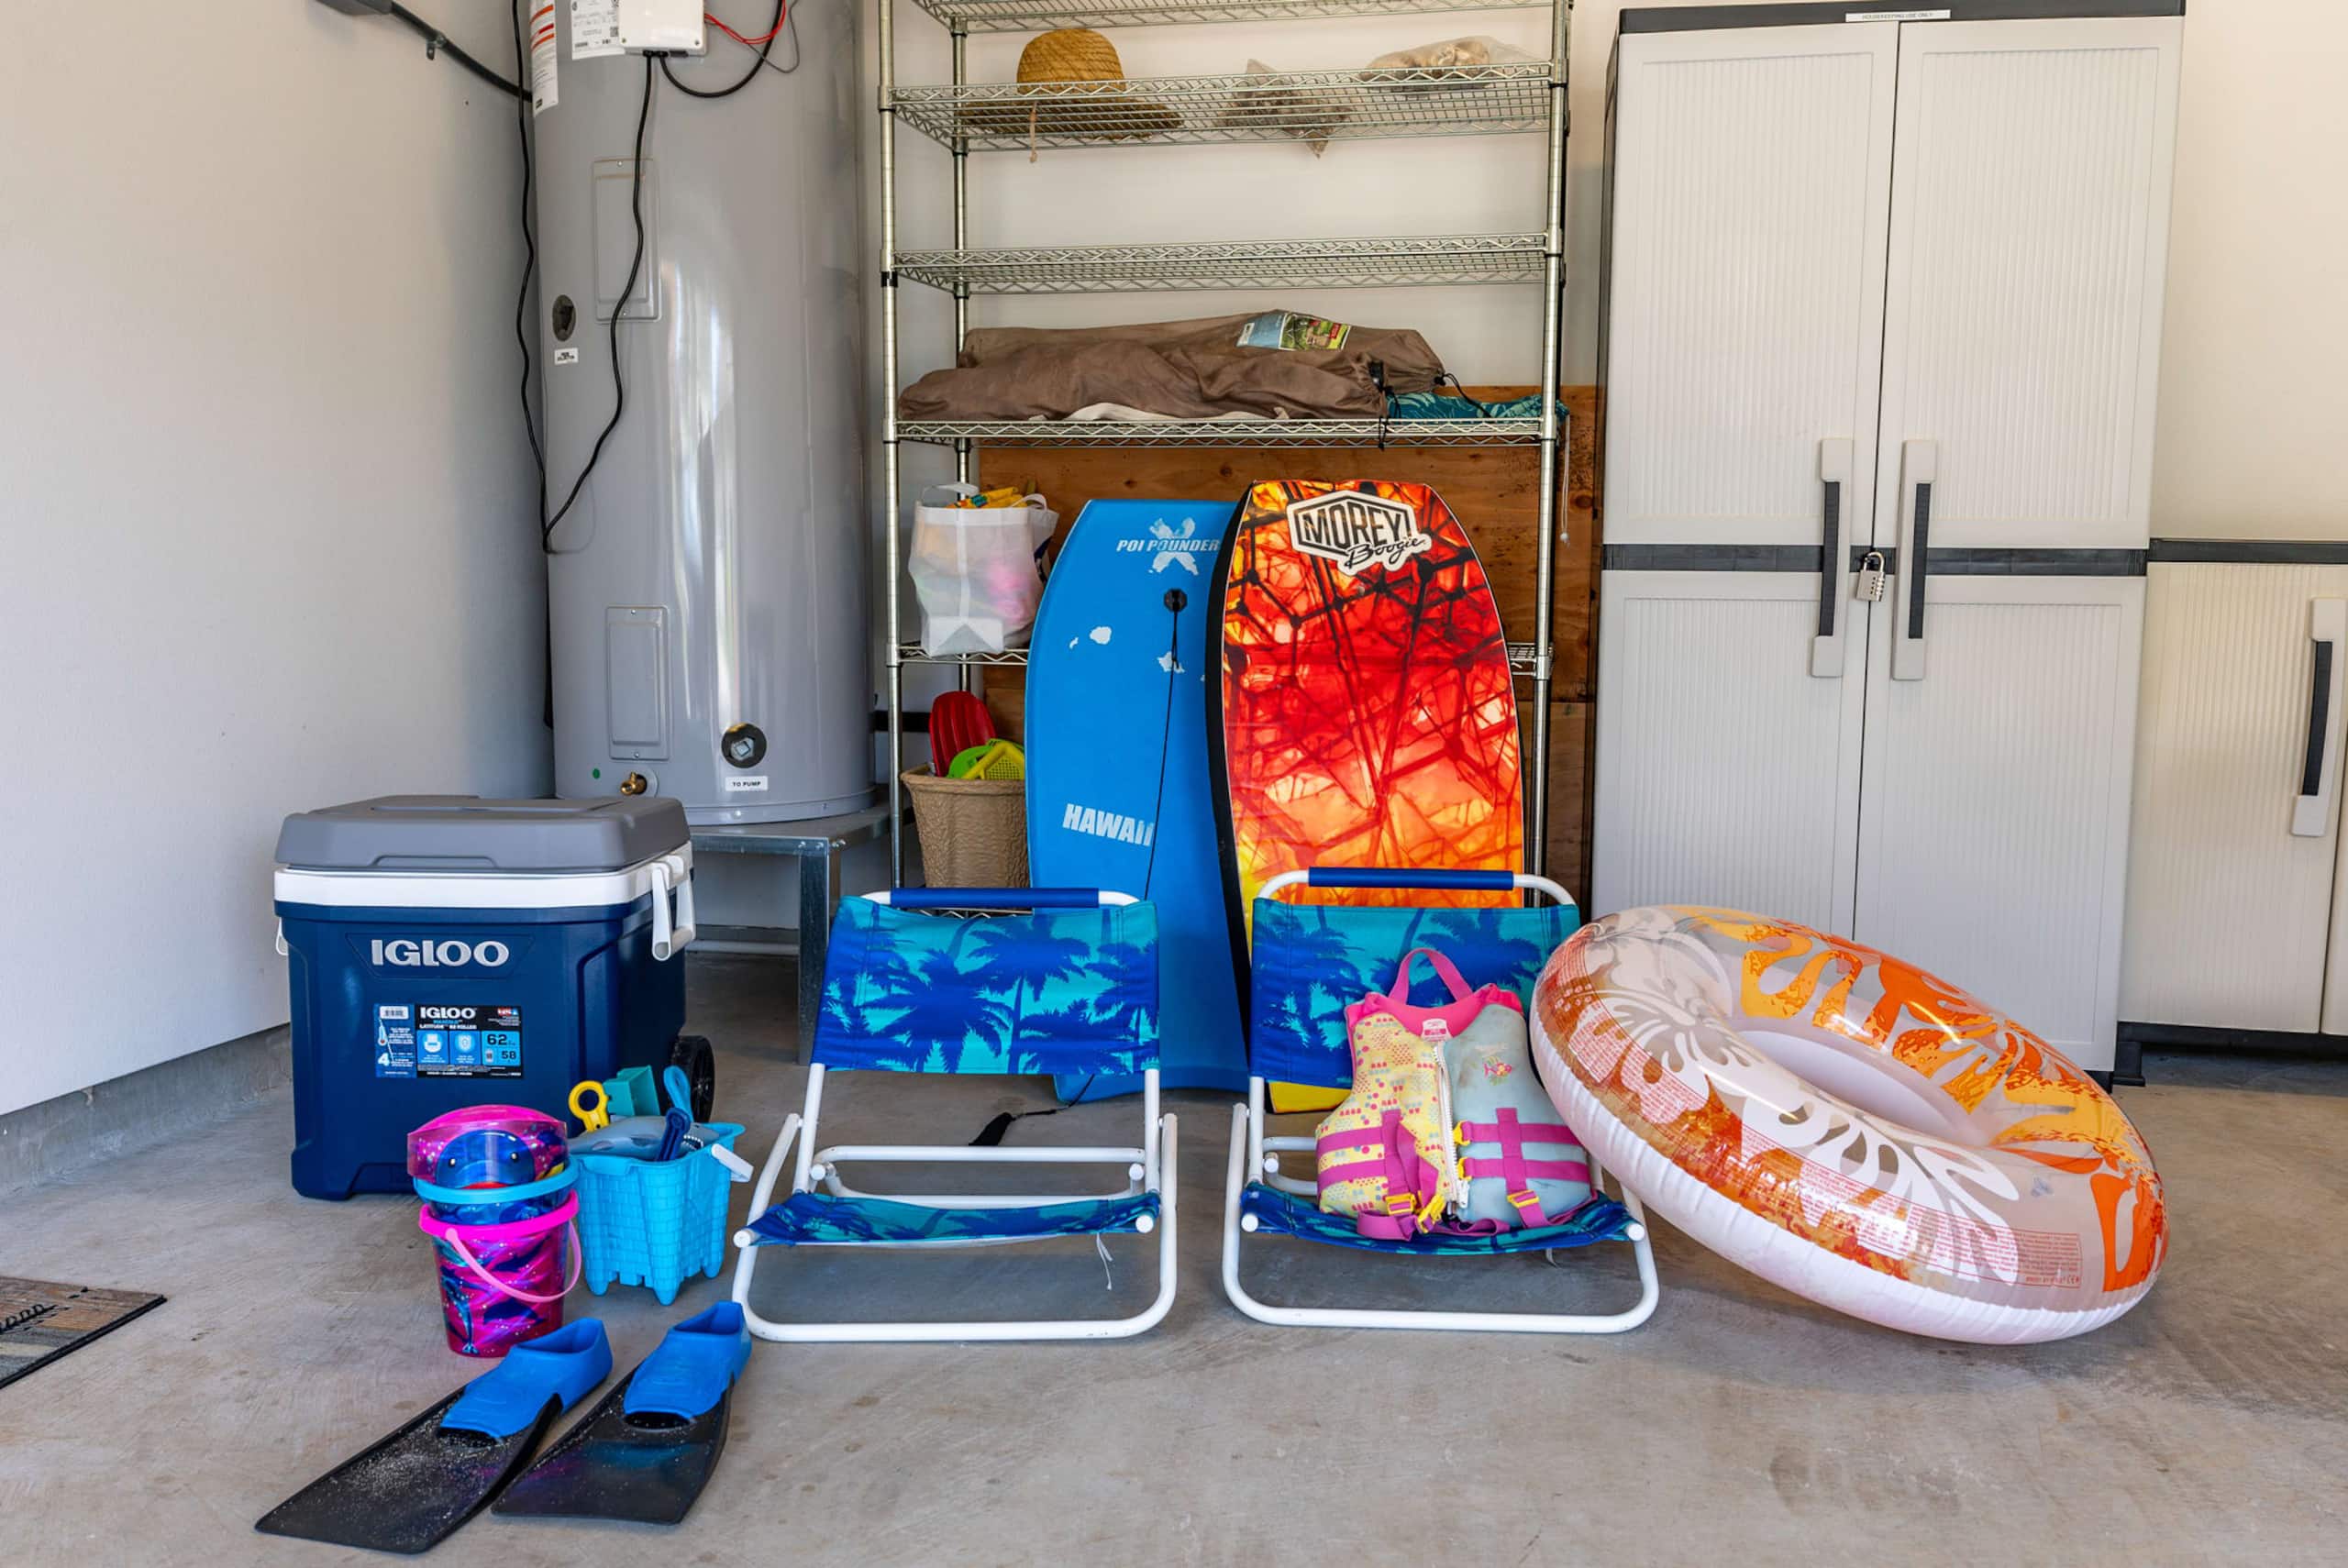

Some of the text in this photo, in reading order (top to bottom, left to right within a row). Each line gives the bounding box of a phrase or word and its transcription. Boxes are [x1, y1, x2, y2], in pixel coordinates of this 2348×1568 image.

[1302, 502, 1401, 549] MOREY
[1116, 539, 1221, 552] POI POUNDER
[1343, 535, 1423, 569] Boogie
[371, 939, 509, 966] IGLOO
[420, 1007, 476, 1020] IGLOO
[487, 1033, 507, 1045] 62
[377, 1053, 390, 1066] 4
[501, 1051, 516, 1060] 58
